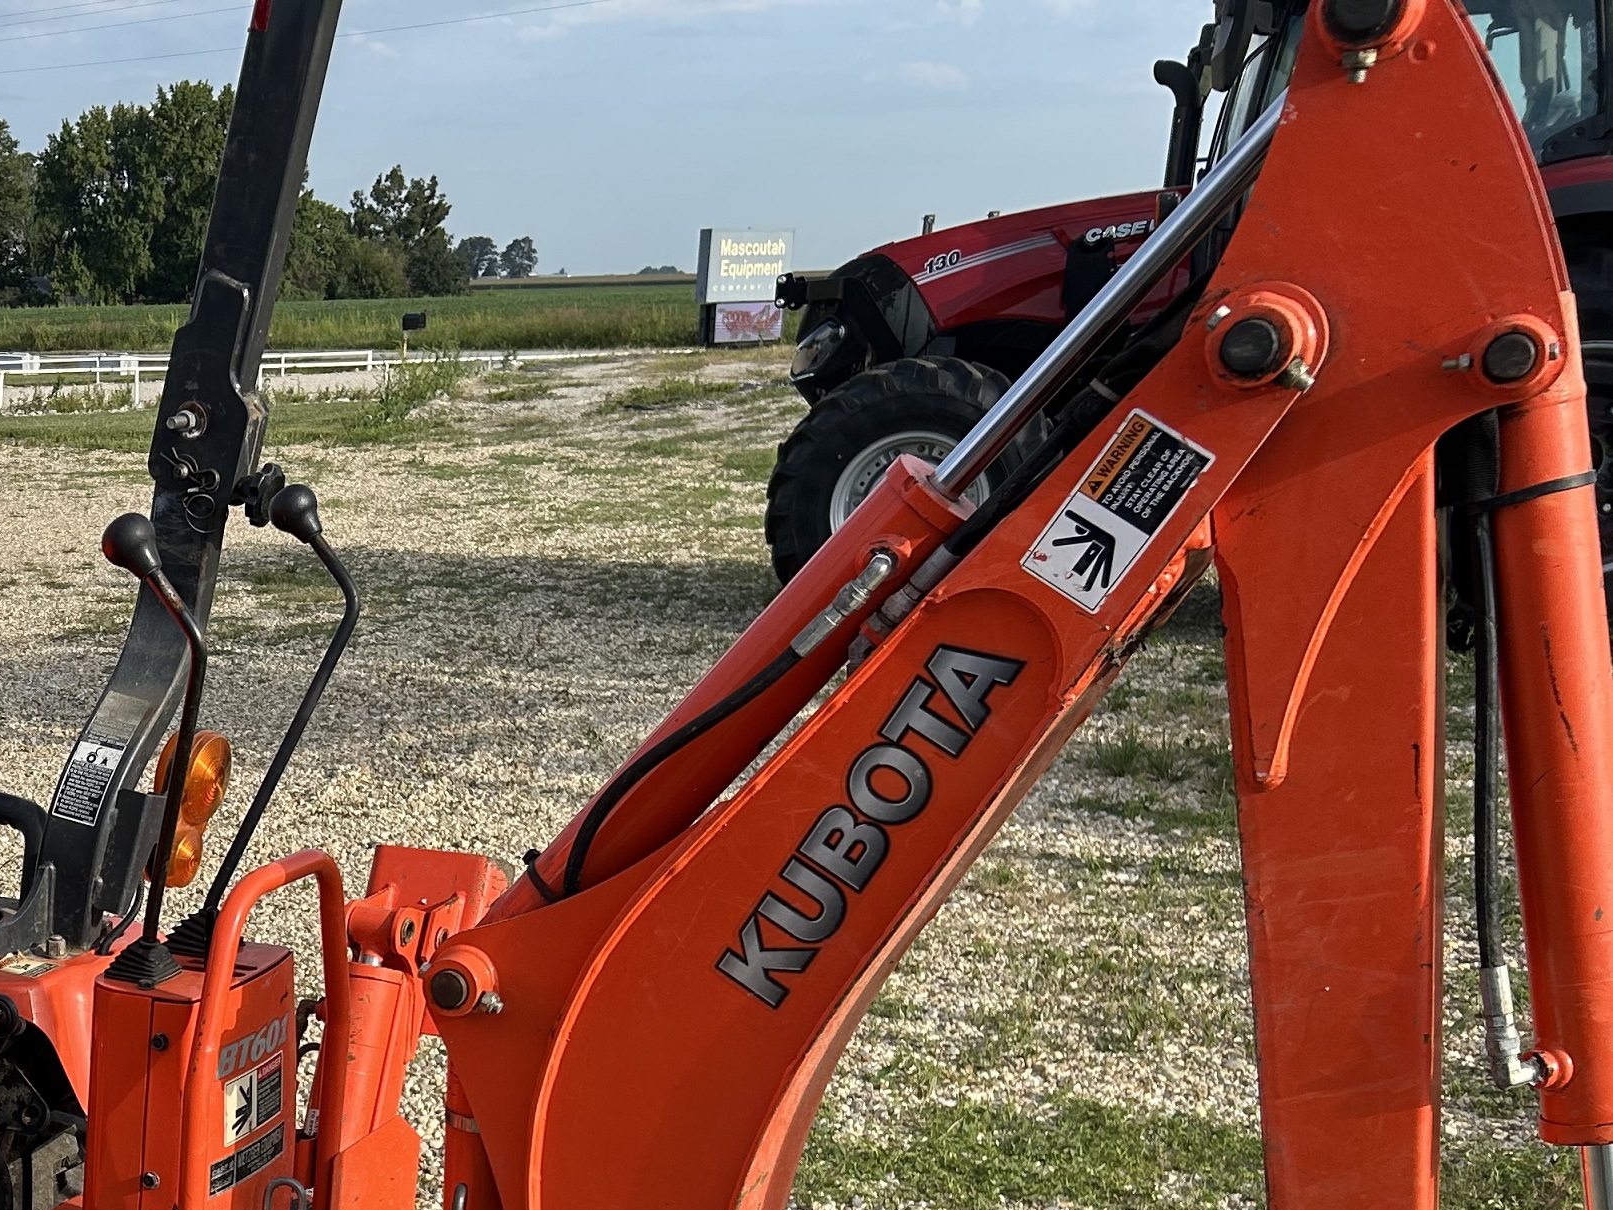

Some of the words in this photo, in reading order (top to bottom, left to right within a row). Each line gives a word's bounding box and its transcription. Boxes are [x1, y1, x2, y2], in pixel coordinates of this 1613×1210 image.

[720, 238, 786, 256] Mascoutah
[1085, 220, 1147, 243] CASE
[720, 259, 783, 280] Equipment
[924, 249, 961, 274] 130
[1096, 421, 1145, 478] WARNING
[1101, 494, 1112, 505] TO
[1111, 470, 1131, 495] AVOID
[1130, 431, 1163, 471] PERSONAL
[1125, 488, 1142, 509] STAY
[1140, 462, 1164, 488] CLEAR
[1160, 449, 1172, 462] OF
[1133, 469, 1170, 513] OPERATING
[1166, 449, 1186, 472] AREA
[1141, 506, 1153, 519] OF
[1150, 490, 1165, 507] THE
[714, 643, 1027, 1010] KUBOTA
[216, 1012, 289, 1080] BT601
